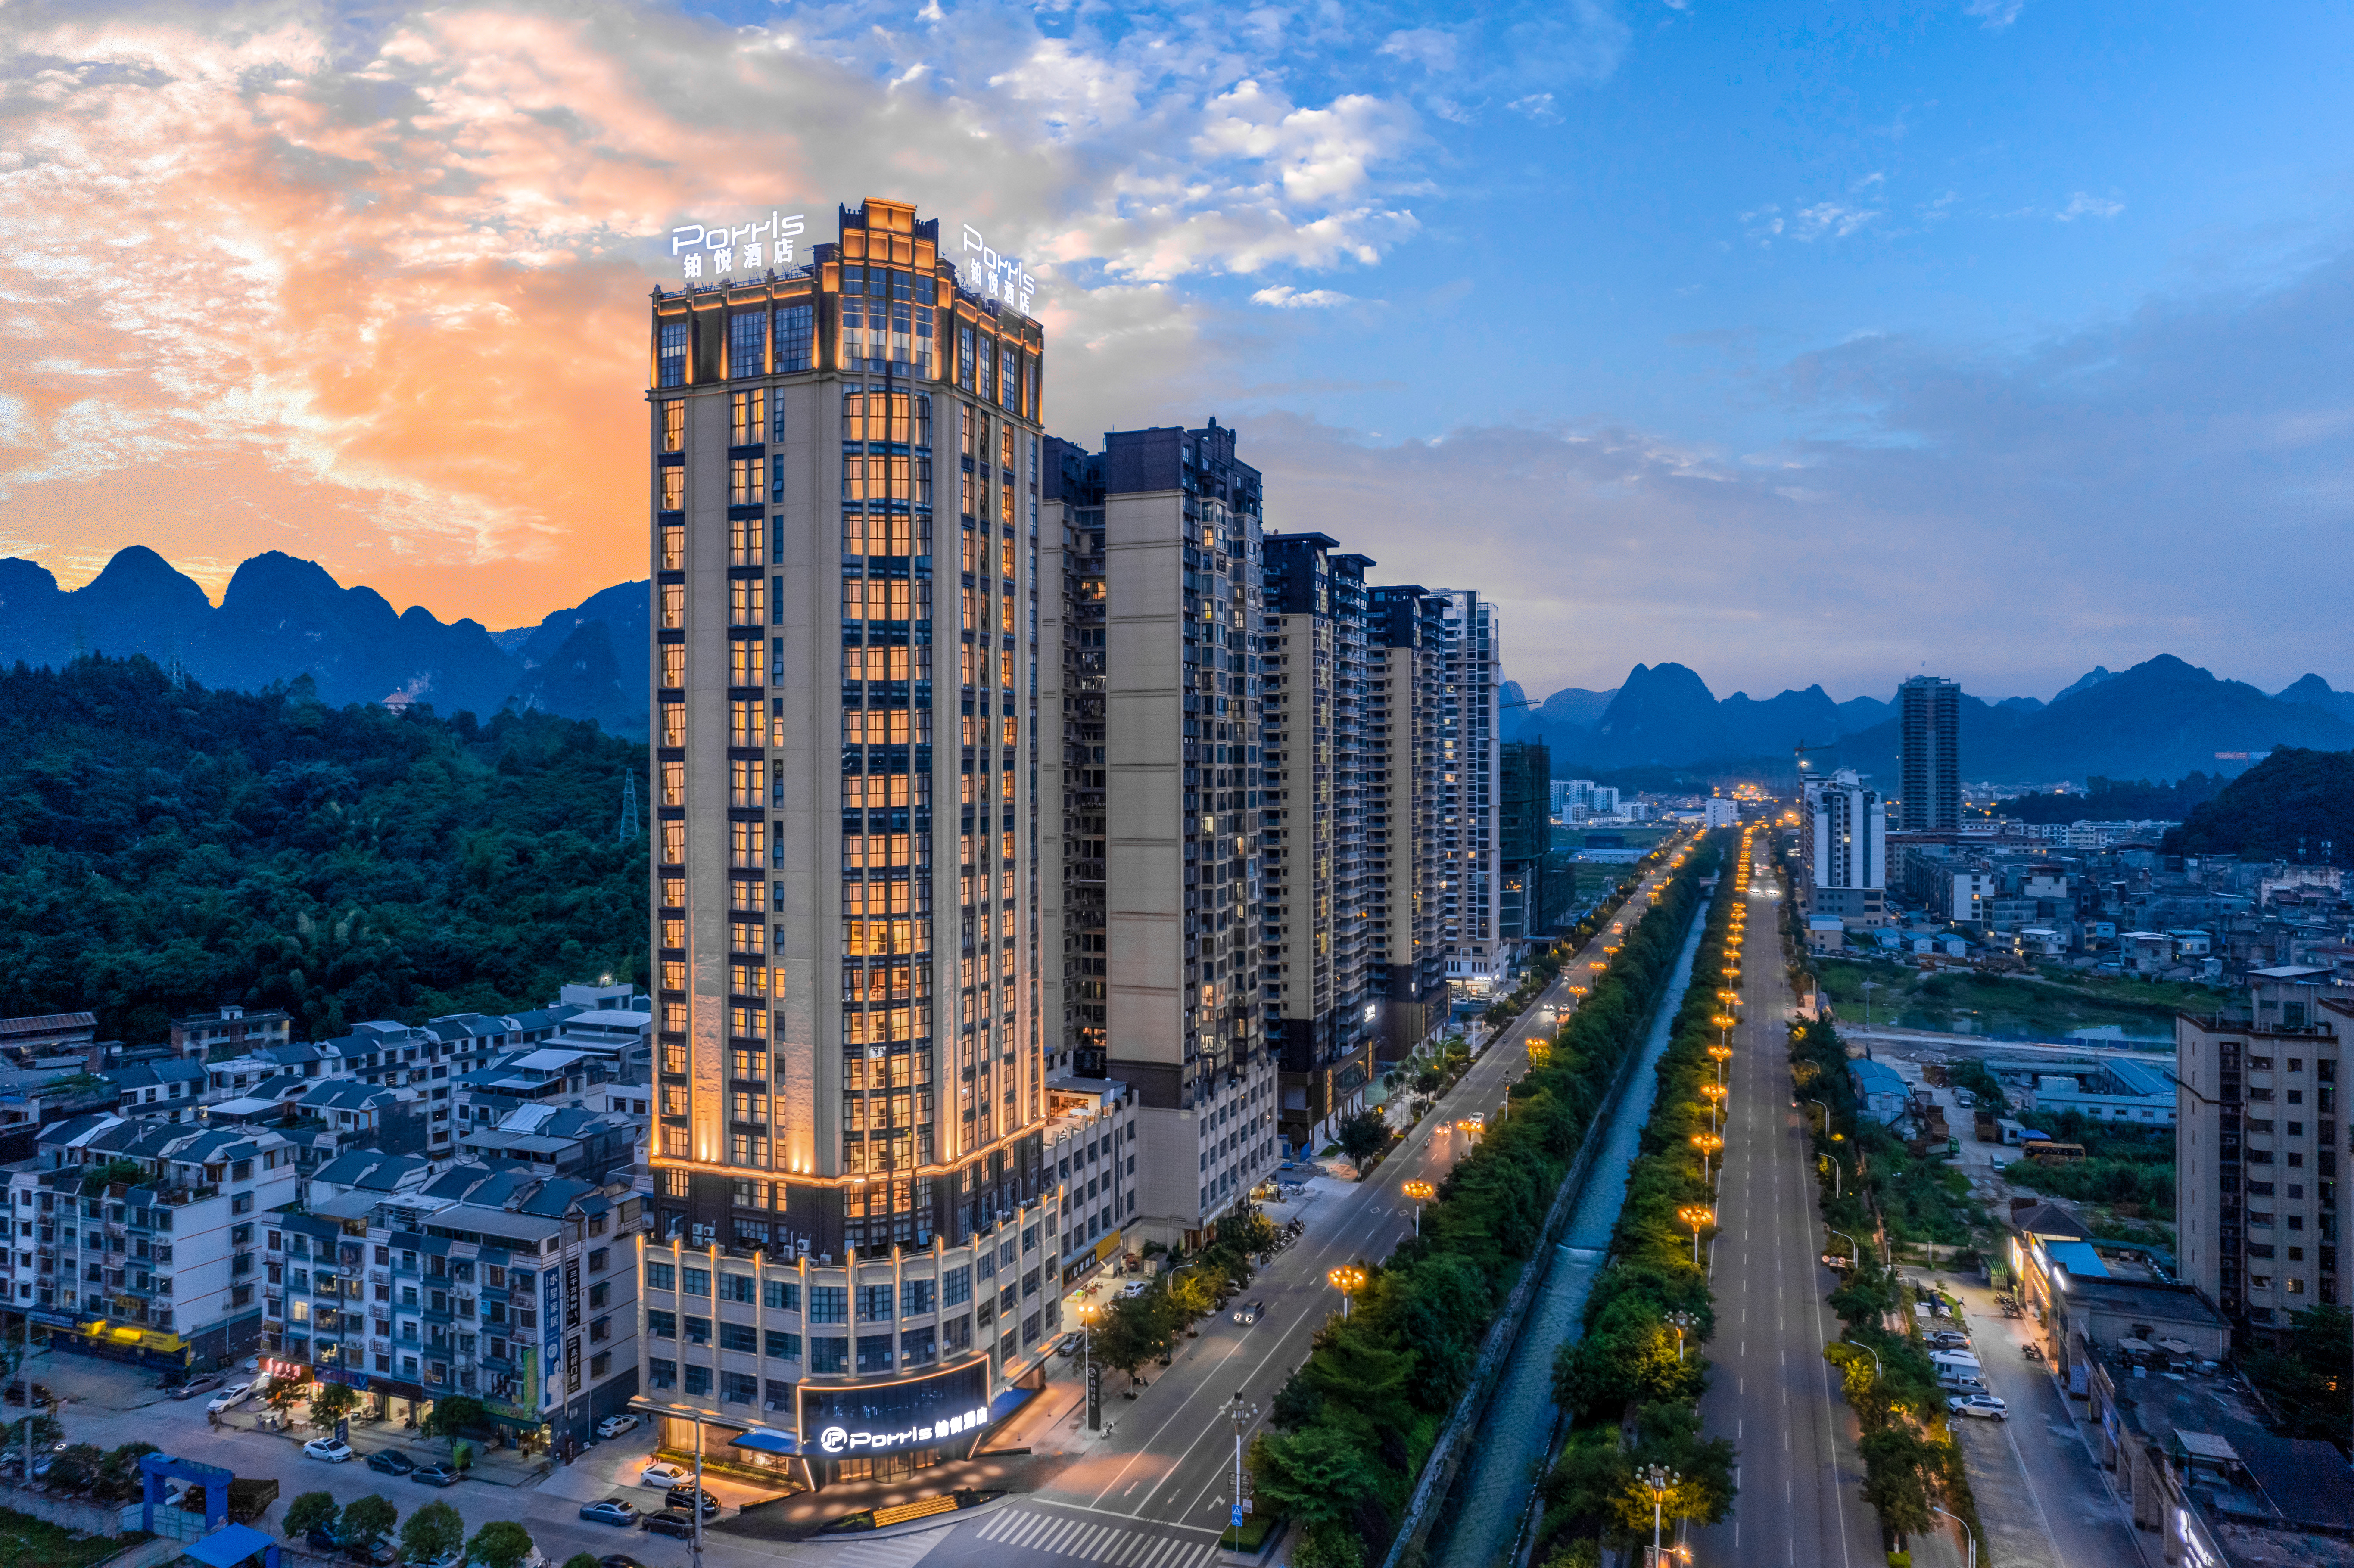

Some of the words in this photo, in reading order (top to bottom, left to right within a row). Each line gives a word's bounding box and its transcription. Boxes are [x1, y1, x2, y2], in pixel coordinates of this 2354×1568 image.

[673, 210, 805, 255] Porris
[683, 238, 794, 279] 铂悦酒店
[963, 223, 1035, 295] Porris
[971, 258, 1030, 316] 铂悦酒店
[549, 1273, 559, 1328] 水星家居
[850, 1426, 933, 1449] Porris
